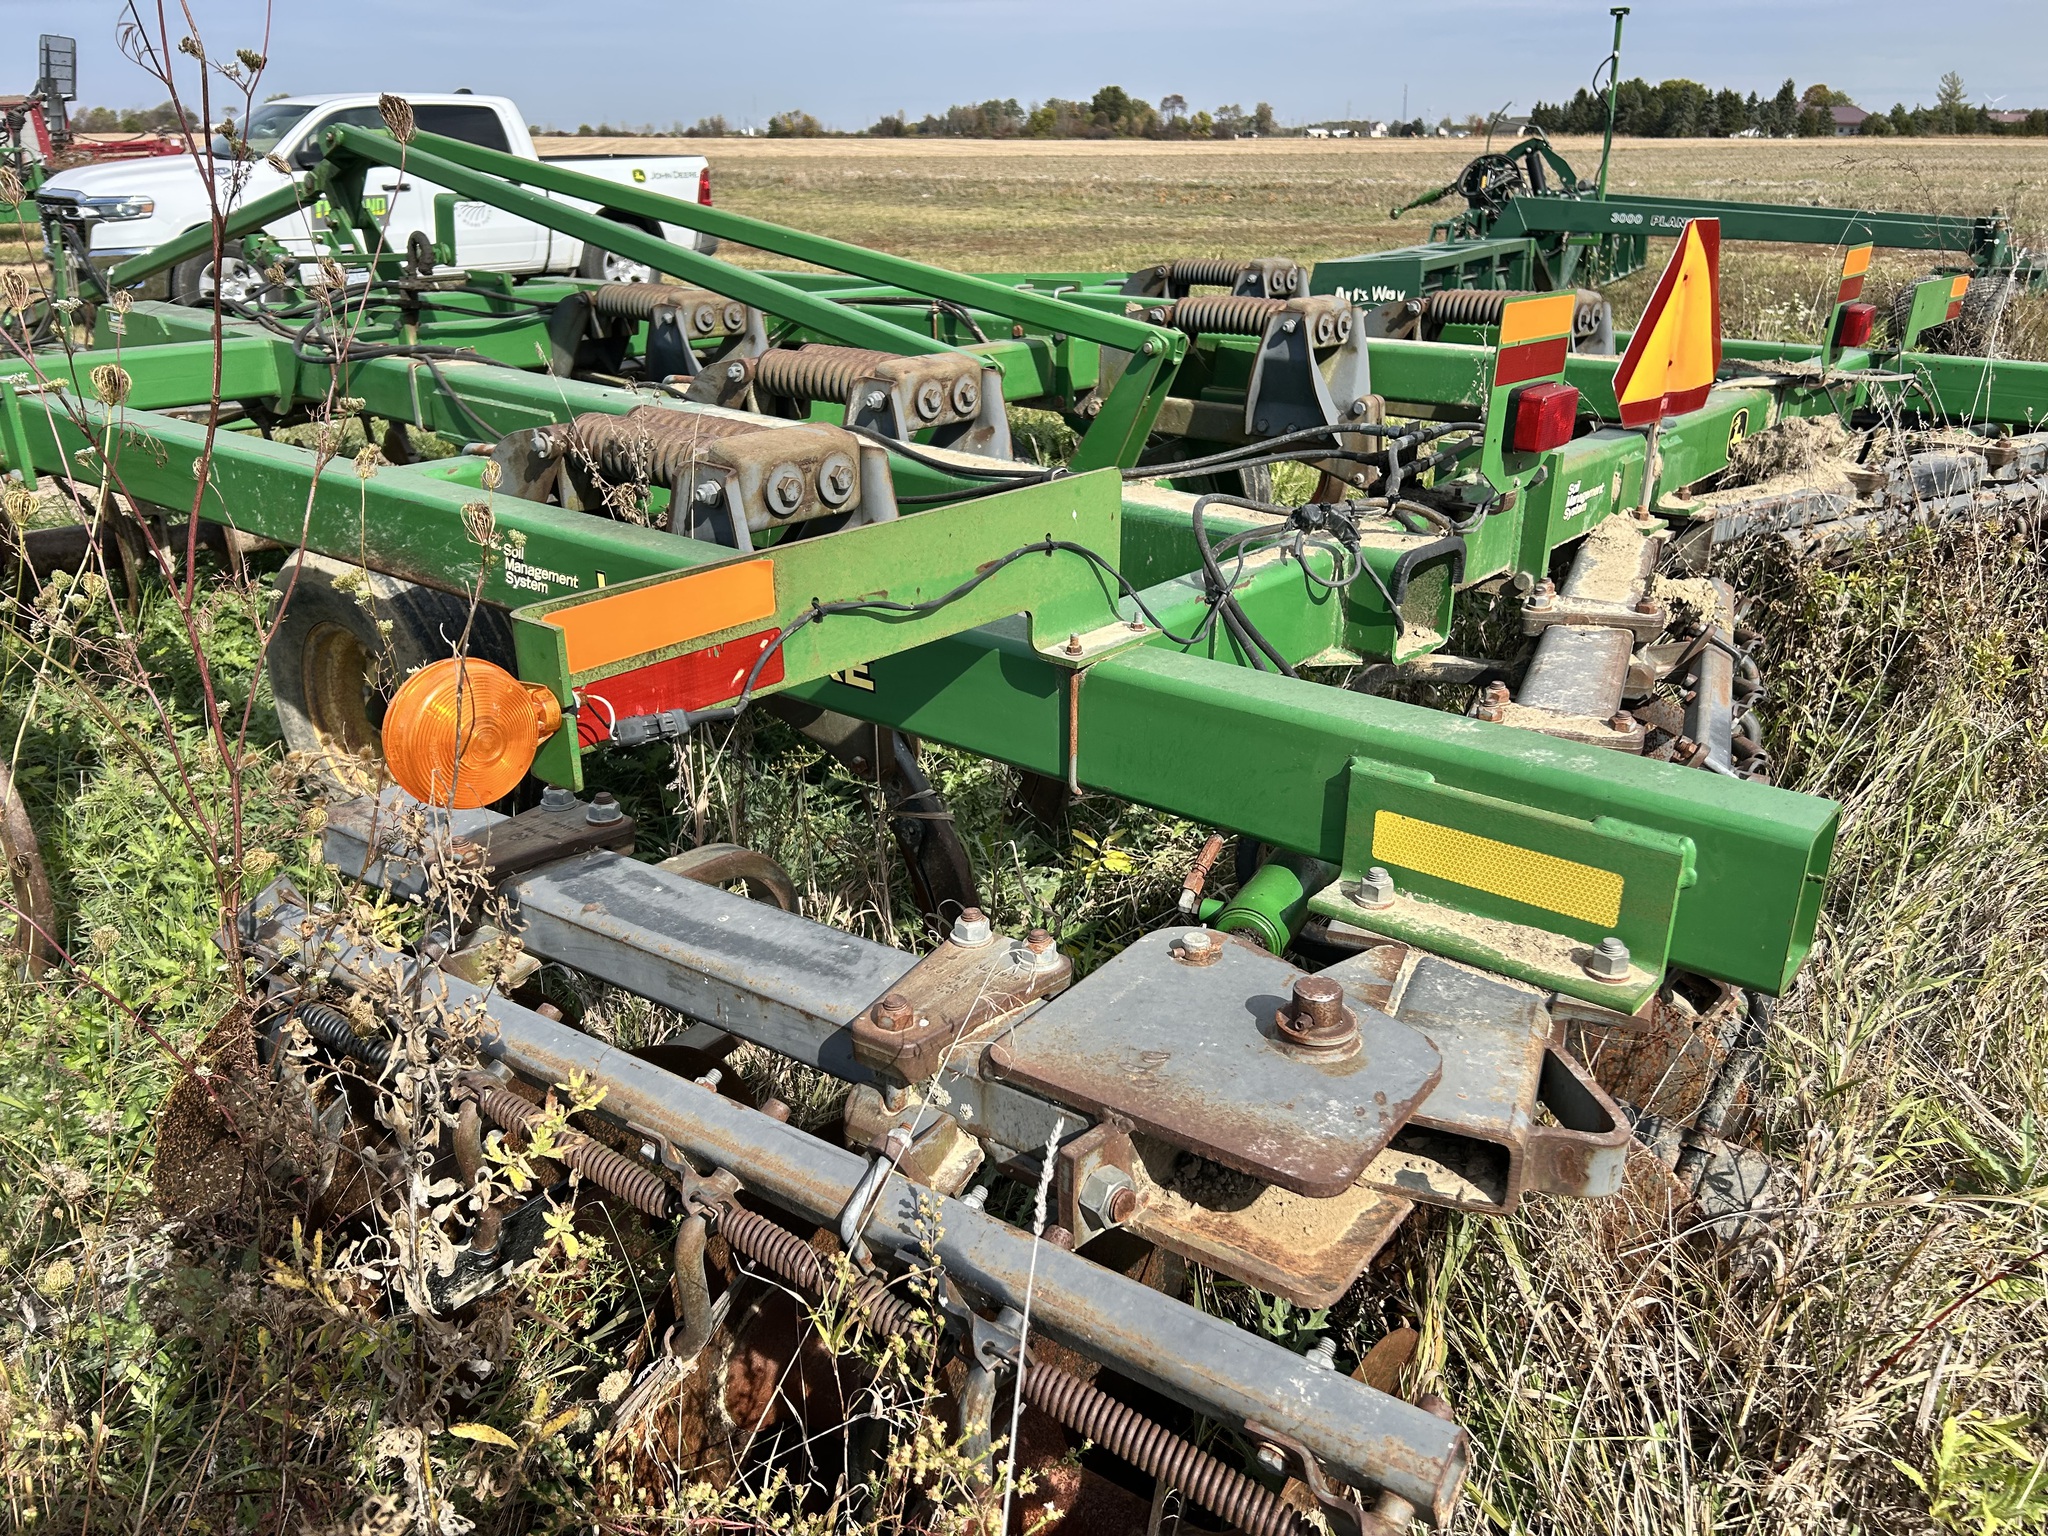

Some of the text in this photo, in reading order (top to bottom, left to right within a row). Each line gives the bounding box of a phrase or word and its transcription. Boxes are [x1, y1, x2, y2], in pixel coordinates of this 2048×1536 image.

[650, 170, 699, 180] JOHN DEERE
[1610, 212, 1643, 225] 3000
[503, 543, 524, 560] Soil
[505, 557, 579, 589] Management
[505, 571, 548, 594] System
